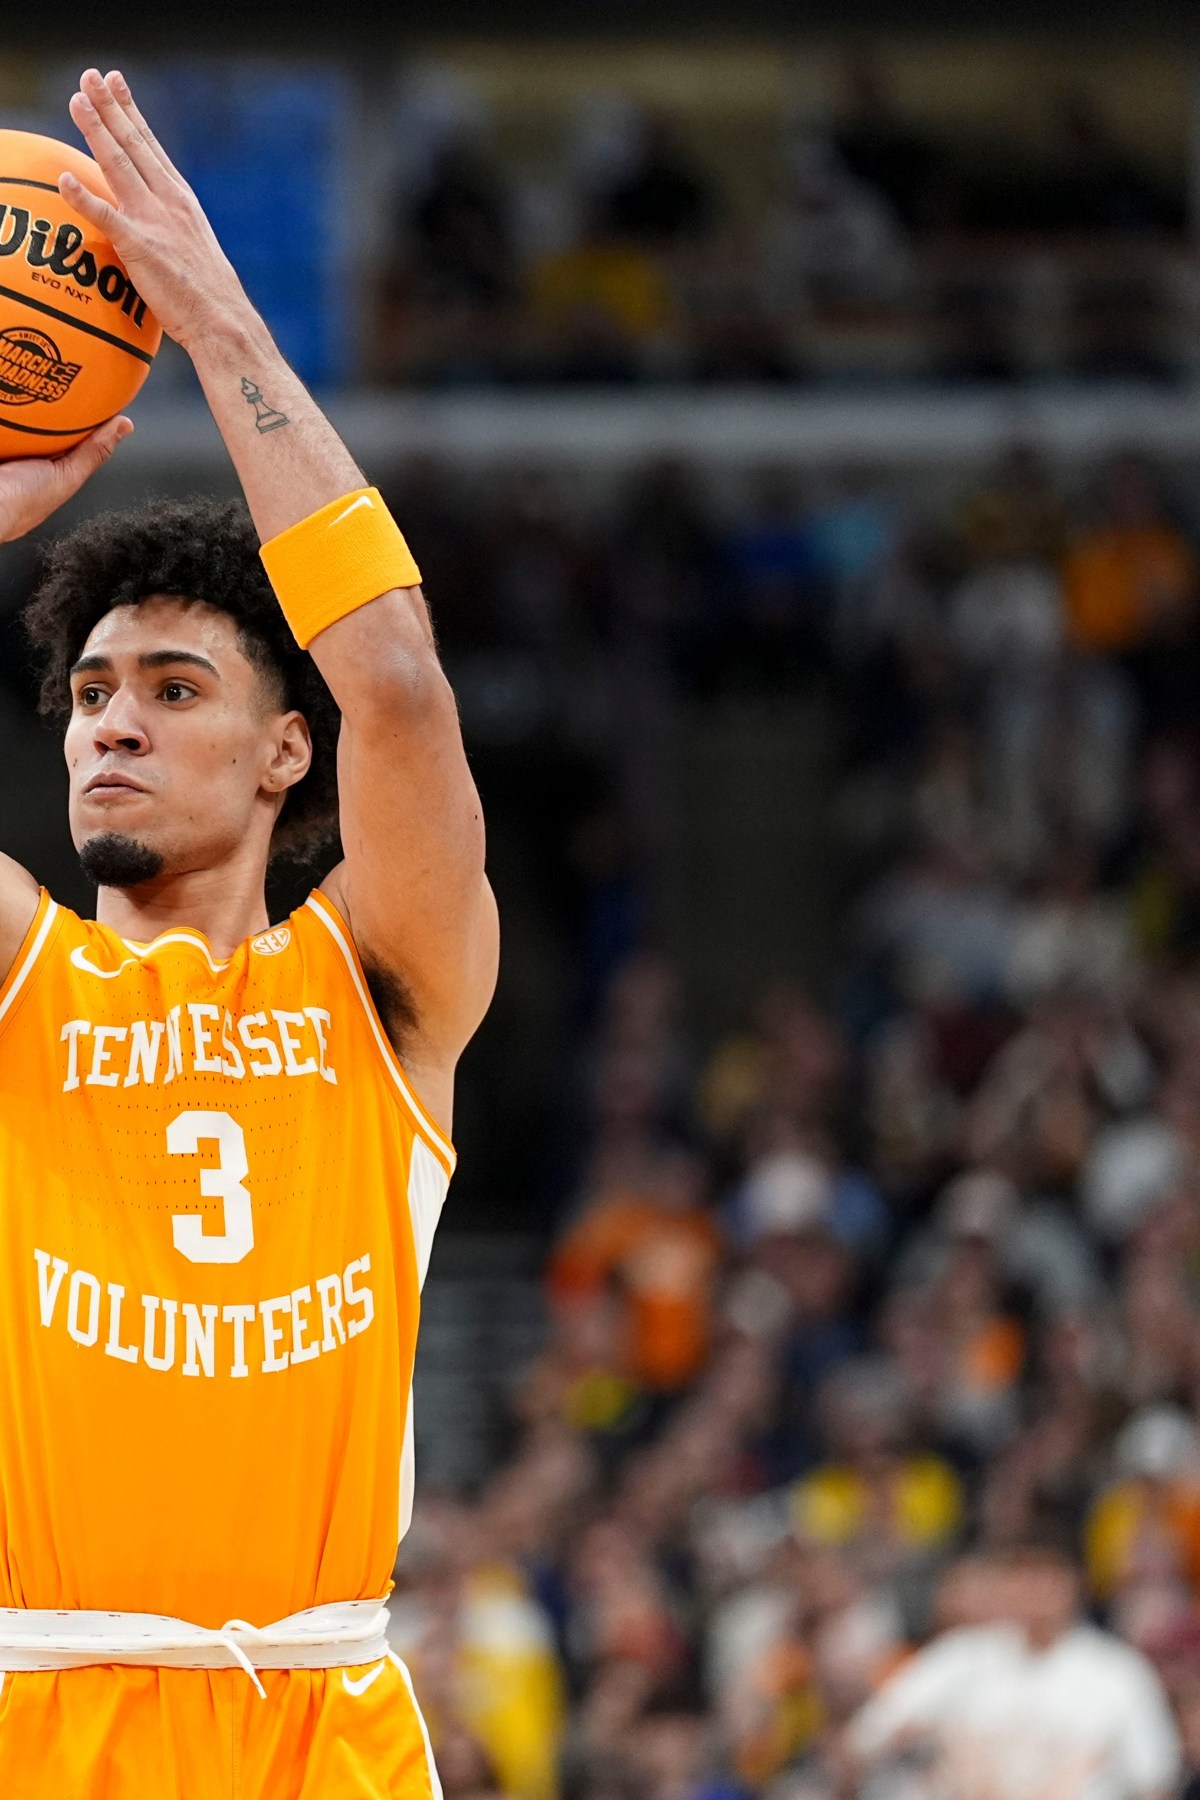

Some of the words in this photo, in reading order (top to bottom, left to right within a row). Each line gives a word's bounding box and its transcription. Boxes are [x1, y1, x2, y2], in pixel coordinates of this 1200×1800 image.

[31, 271, 61, 290] EVO
[64, 285, 93, 305] NXT
[253, 929, 288, 953] SEC
[59, 1002, 338, 1094] TENNESSEE
[165, 1110, 255, 1264] 3
[33, 1247, 375, 1378] VOLUNTEERS
